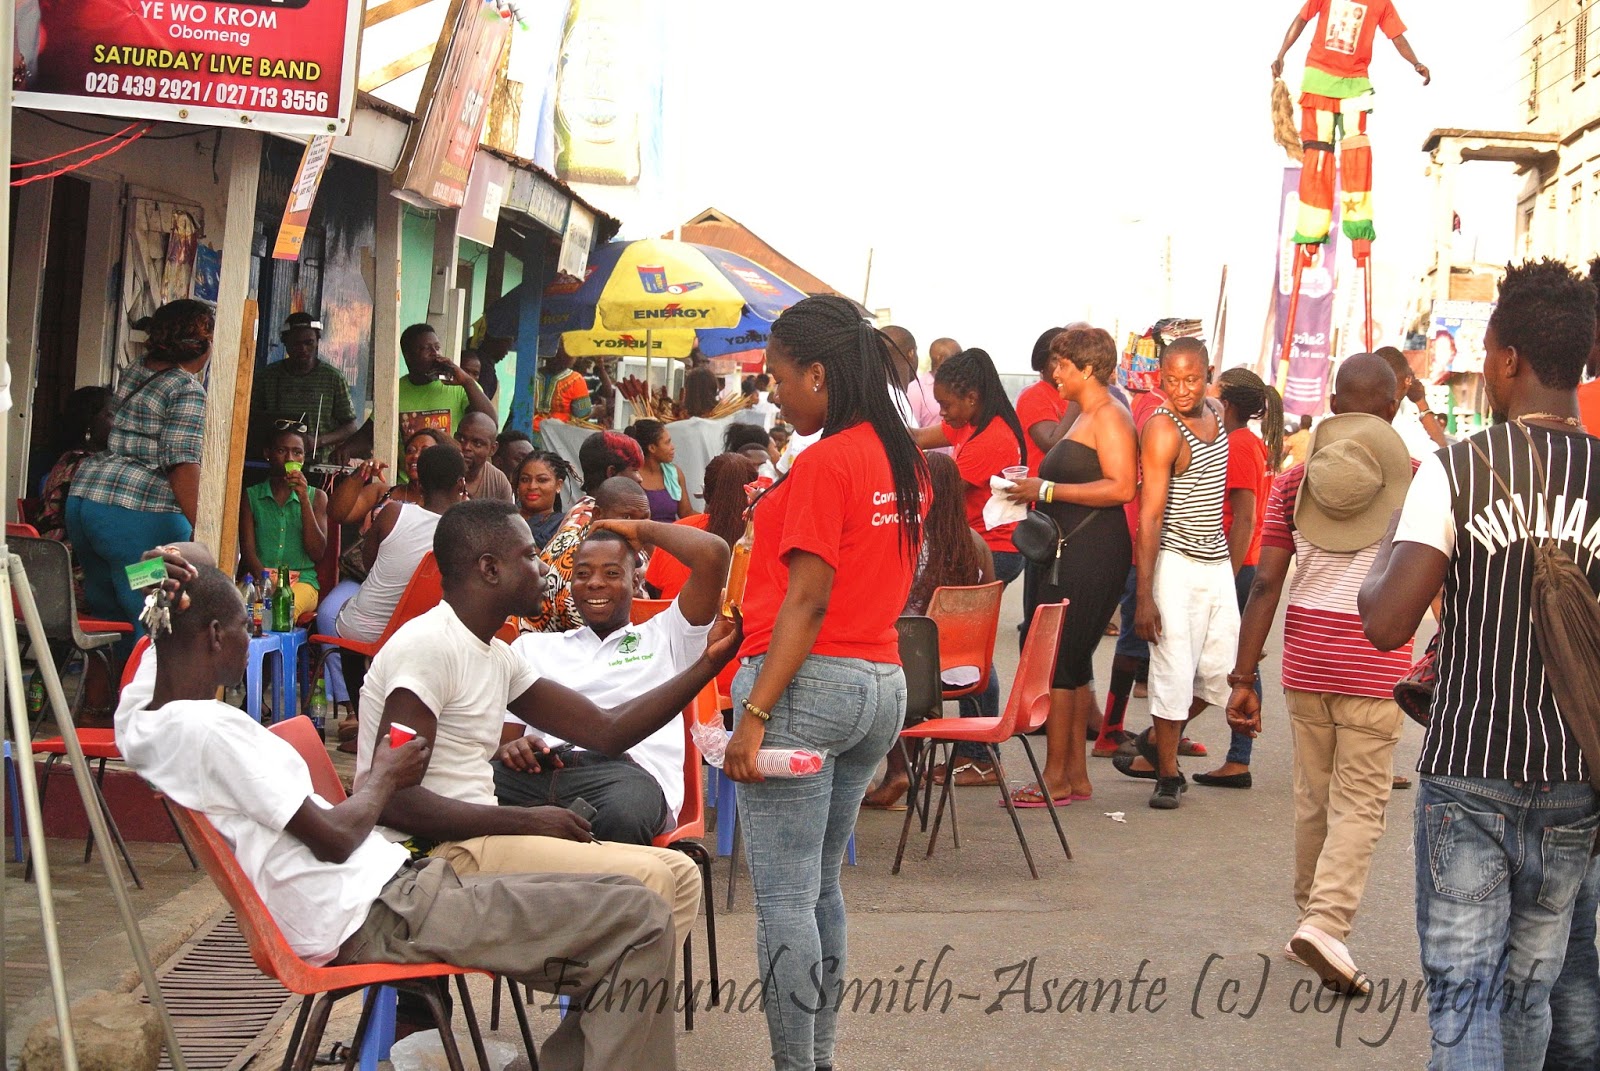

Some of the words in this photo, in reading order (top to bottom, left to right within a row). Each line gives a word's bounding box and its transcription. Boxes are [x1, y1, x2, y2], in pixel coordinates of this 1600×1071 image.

[140, 1, 163, 20] YE
[170, 4, 207, 23] WO
[214, 7, 277, 29] KROM
[169, 24, 250, 46] Obomeng
[94, 45, 204, 71] SATURDAY
[210, 54, 253, 75] LIVE
[260, 59, 321, 81] BAND
[85, 72, 119, 93] 026
[122, 75, 155, 97] 439
[159, 78, 200, 101] 2921
[216, 83, 246, 105] 027
[250, 86, 277, 108] 713
[282, 89, 328, 112] 3556
[633, 309, 710, 319] ENERGY
[424, 416, 431, 428] 3
[437, 415, 448, 428] 10
